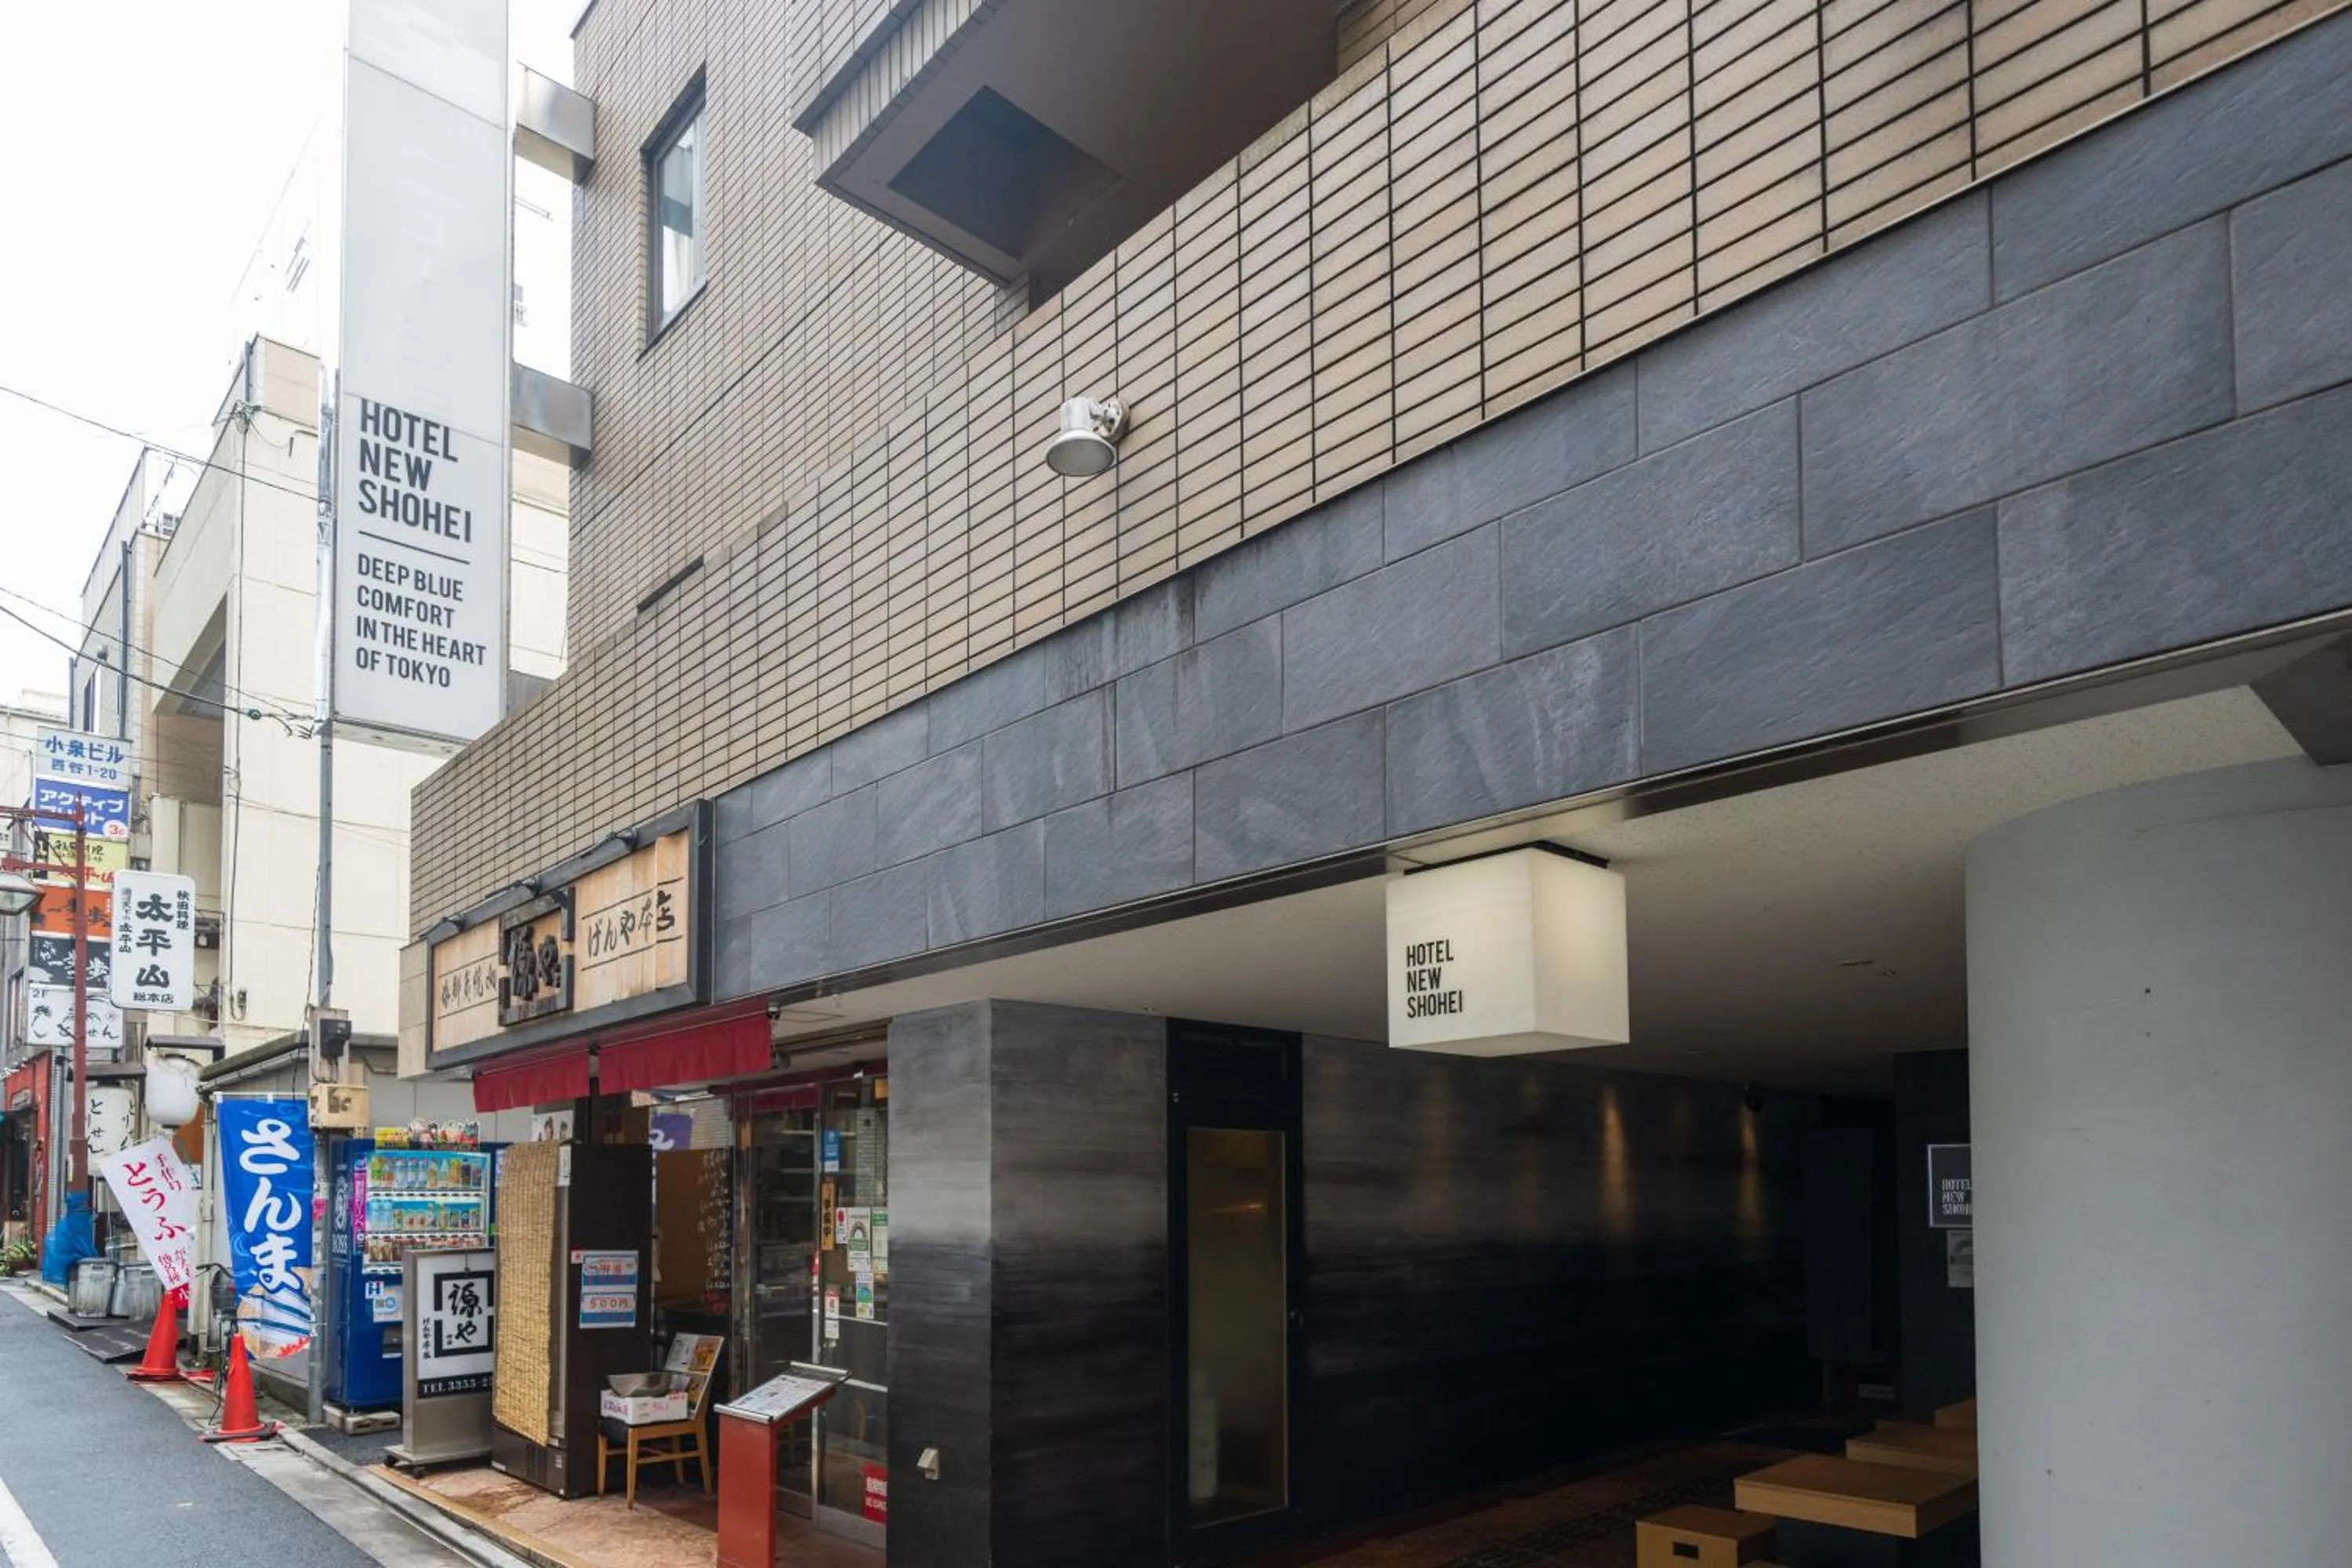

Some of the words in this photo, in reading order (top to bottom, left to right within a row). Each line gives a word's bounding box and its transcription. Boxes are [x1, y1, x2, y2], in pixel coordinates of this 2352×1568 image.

[361, 397, 459, 463] HOTEL
[360, 437, 433, 492] NEW
[358, 479, 471, 543] SHOHEI
[358, 553, 410, 586] DEEP
[414, 569, 464, 602] BLUE
[357, 585, 456, 628] COMFORT
[356, 615, 377, 641] IN
[380, 621, 419, 651] THE
[423, 631, 487, 666] HEART
[356, 647, 382, 671] OF
[385, 653, 451, 688] TOKYO
[45, 735, 125, 764] 小泉ビル
[176, 890, 190, 931] 秋田料理
[586, 891, 675, 959] げんや本店
[136, 893, 174, 989] 太平山
[1406, 938, 1454, 967] HOTEL
[132, 991, 174, 1005] 総本店
[1406, 967, 1443, 993] NEW
[1407, 989, 1463, 1019] SHOHEI
[122, 1161, 187, 1242] とうふ
[238, 1118, 306, 1294] さんま
[1942, 1191, 1965, 1203] NEW
[448, 1282, 482, 1343] 源や
[423, 1380, 446, 1394] TEL
